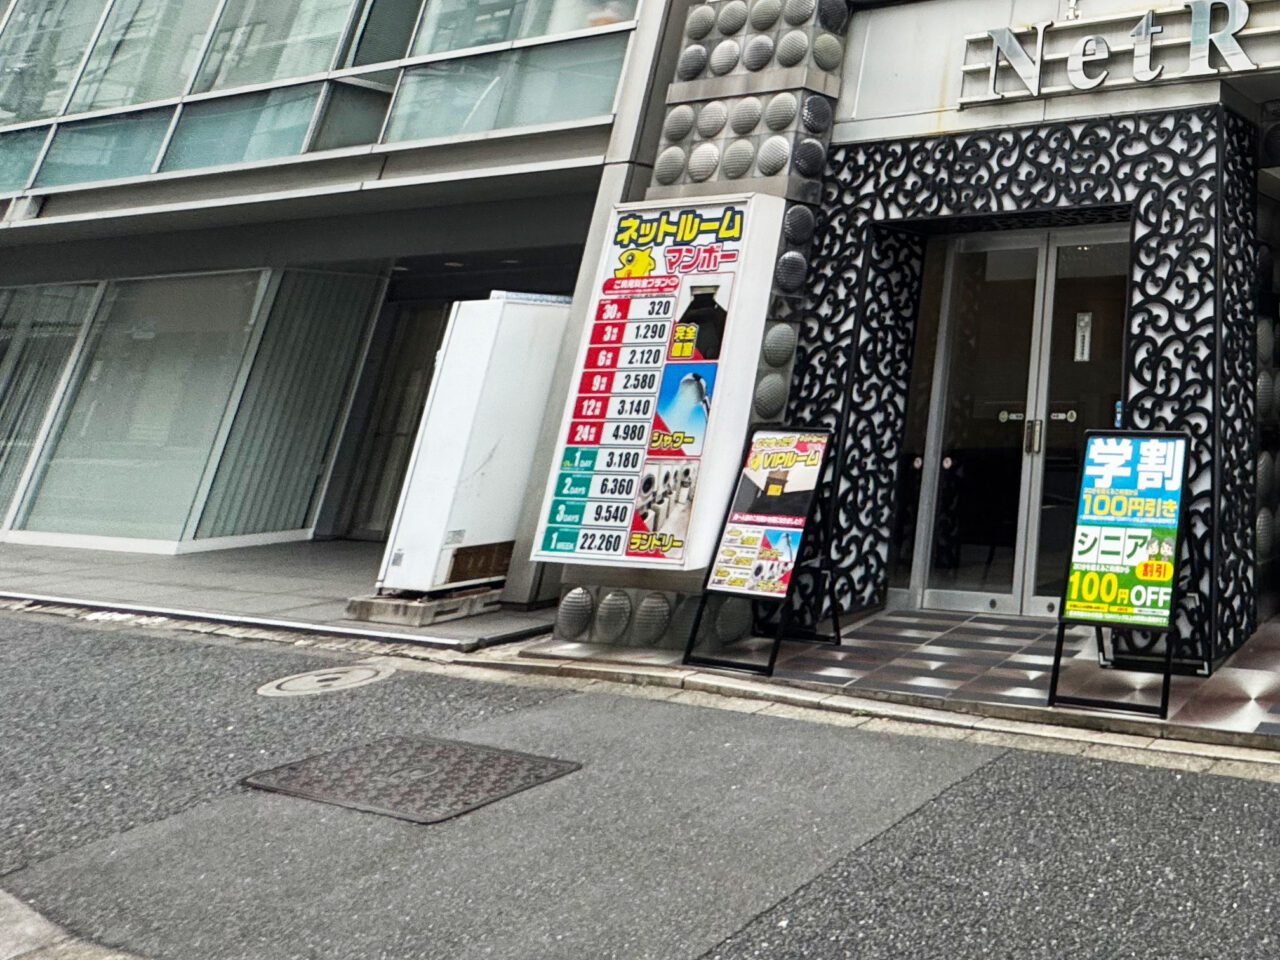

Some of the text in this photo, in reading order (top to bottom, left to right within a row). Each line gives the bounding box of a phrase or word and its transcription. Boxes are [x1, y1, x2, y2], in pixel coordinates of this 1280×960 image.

[614, 207, 743, 248] ネットルーム
[664, 243, 739, 273] マンボー
[648, 300, 671, 315] 320
[650, 431, 695, 449] シャワー
[763, 450, 820, 469] VIPルーム
[1085, 437, 1186, 491] 学割
[1083, 494, 1178, 518] 100円引き
[629, 531, 684, 553] ランドリー
[1077, 532, 1150, 560] シニア
